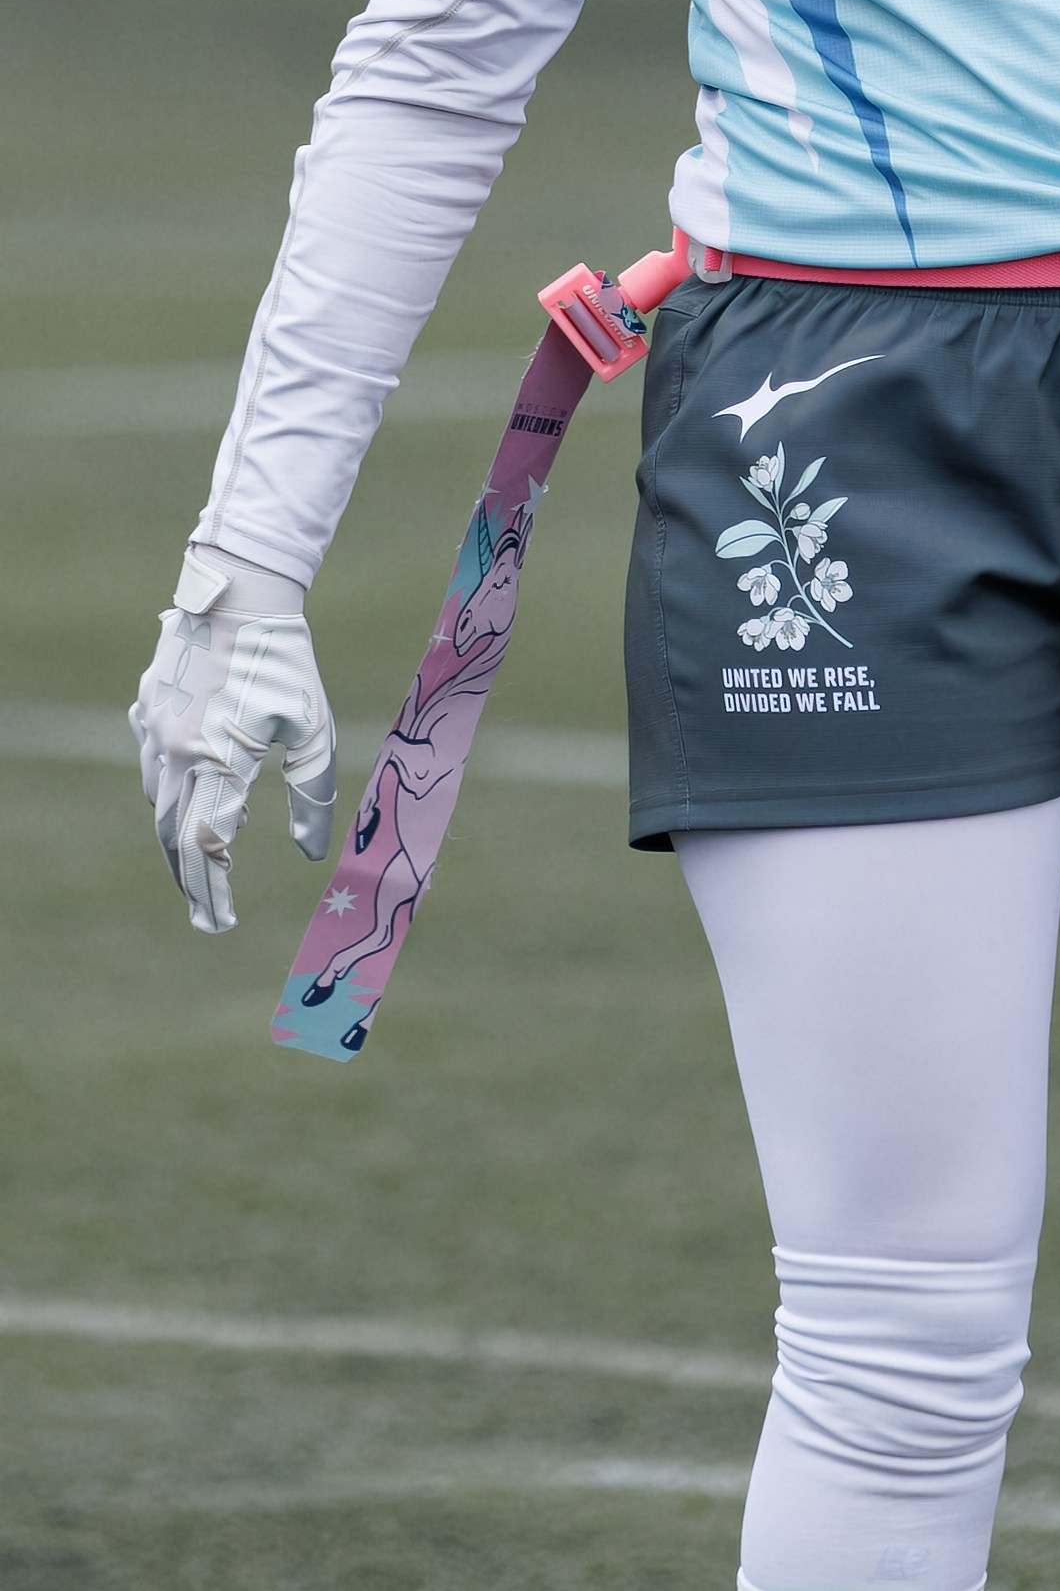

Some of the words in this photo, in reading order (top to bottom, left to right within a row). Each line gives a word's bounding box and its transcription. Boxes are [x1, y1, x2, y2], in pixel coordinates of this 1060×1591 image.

[511, 414, 563, 436] UNICORNS
[722, 668, 783, 688] UNITED
[787, 668, 818, 688] WE
[824, 666, 875, 688] RISE,
[724, 693, 792, 712] DIVIDED
[796, 693, 827, 712] WE
[832, 691, 881, 712] FALL
